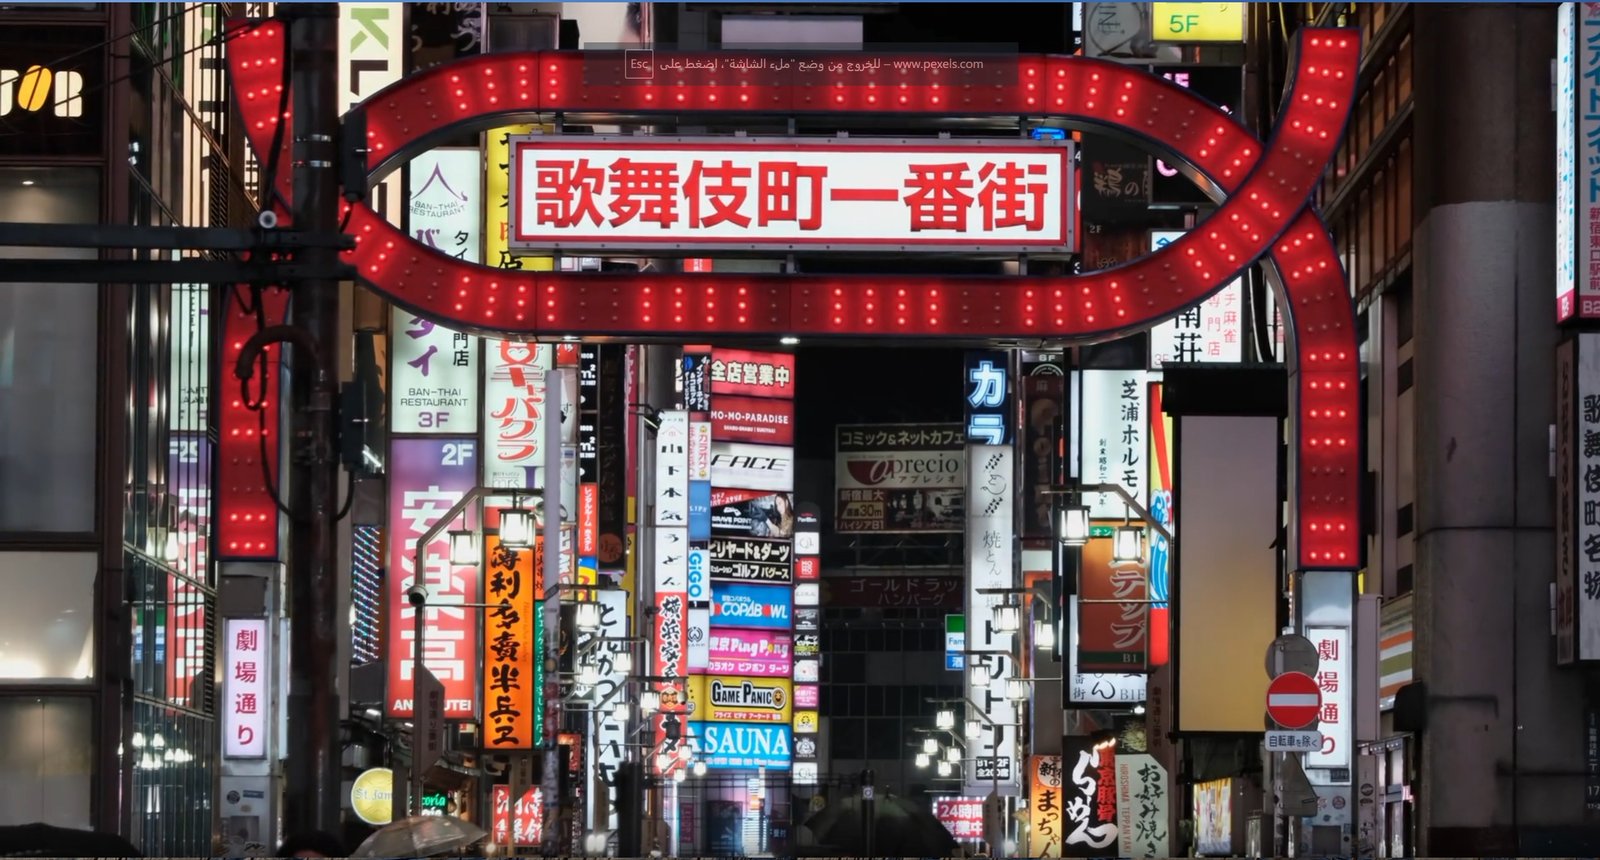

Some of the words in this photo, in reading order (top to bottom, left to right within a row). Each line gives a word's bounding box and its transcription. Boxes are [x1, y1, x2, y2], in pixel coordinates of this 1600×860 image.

[1170, 15, 1198, 33] 5F
[414, 199, 459, 211] BAN-THAI
[535, 157, 1049, 233] 歌舞伎町一番街
[711, 359, 790, 387] 全店営業中
[400, 398, 468, 407] RESTAURANT
[408, 387, 461, 397] BAN-THAI
[418, 411, 450, 428] 3F
[441, 443, 473, 466] 2F
[709, 541, 789, 562] ビリヤード&ダーツ
[688, 552, 703, 598] GiGO
[234, 629, 258, 746] 劇場通り
[712, 682, 741, 704] GAME
[743, 683, 773, 705] PANIC
[1317, 639, 1339, 755] 劇場通り
[393, 699, 472, 712] ANTEI
[705, 727, 791, 756] SAUNA
[1268, 735, 1319, 748] 自転車を除く
[1120, 763, 1130, 803] HIROSHIMA
